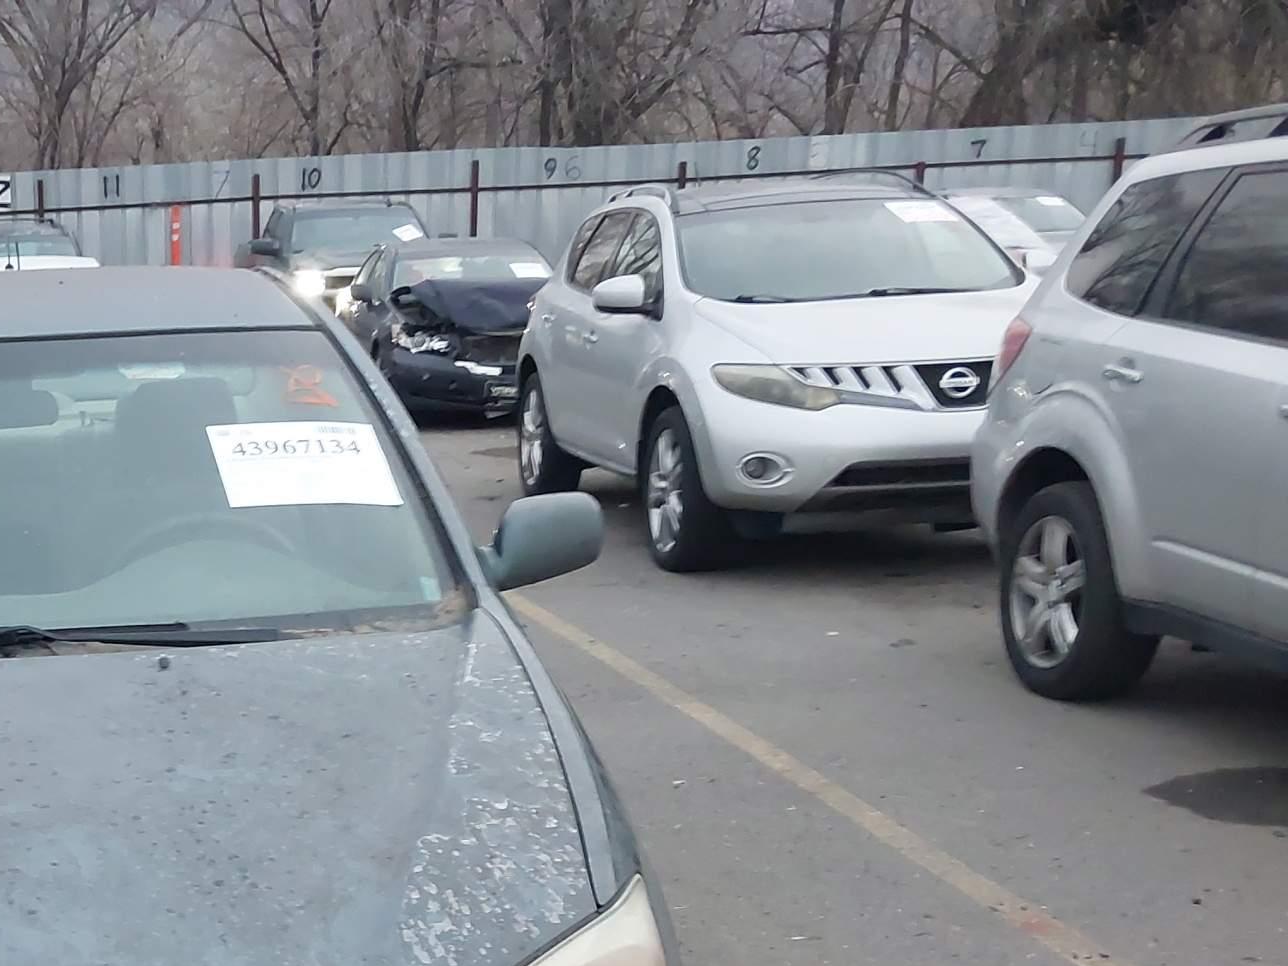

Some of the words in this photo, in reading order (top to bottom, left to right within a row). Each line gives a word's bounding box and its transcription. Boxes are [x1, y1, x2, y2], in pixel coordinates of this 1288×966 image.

[745, 145, 761, 171] 8
[970, 138, 988, 159] 7
[301, 167, 322, 192] 10
[543, 157, 558, 180] 9
[103, 174, 120, 199] 11
[231, 438, 362, 457] 43967134
